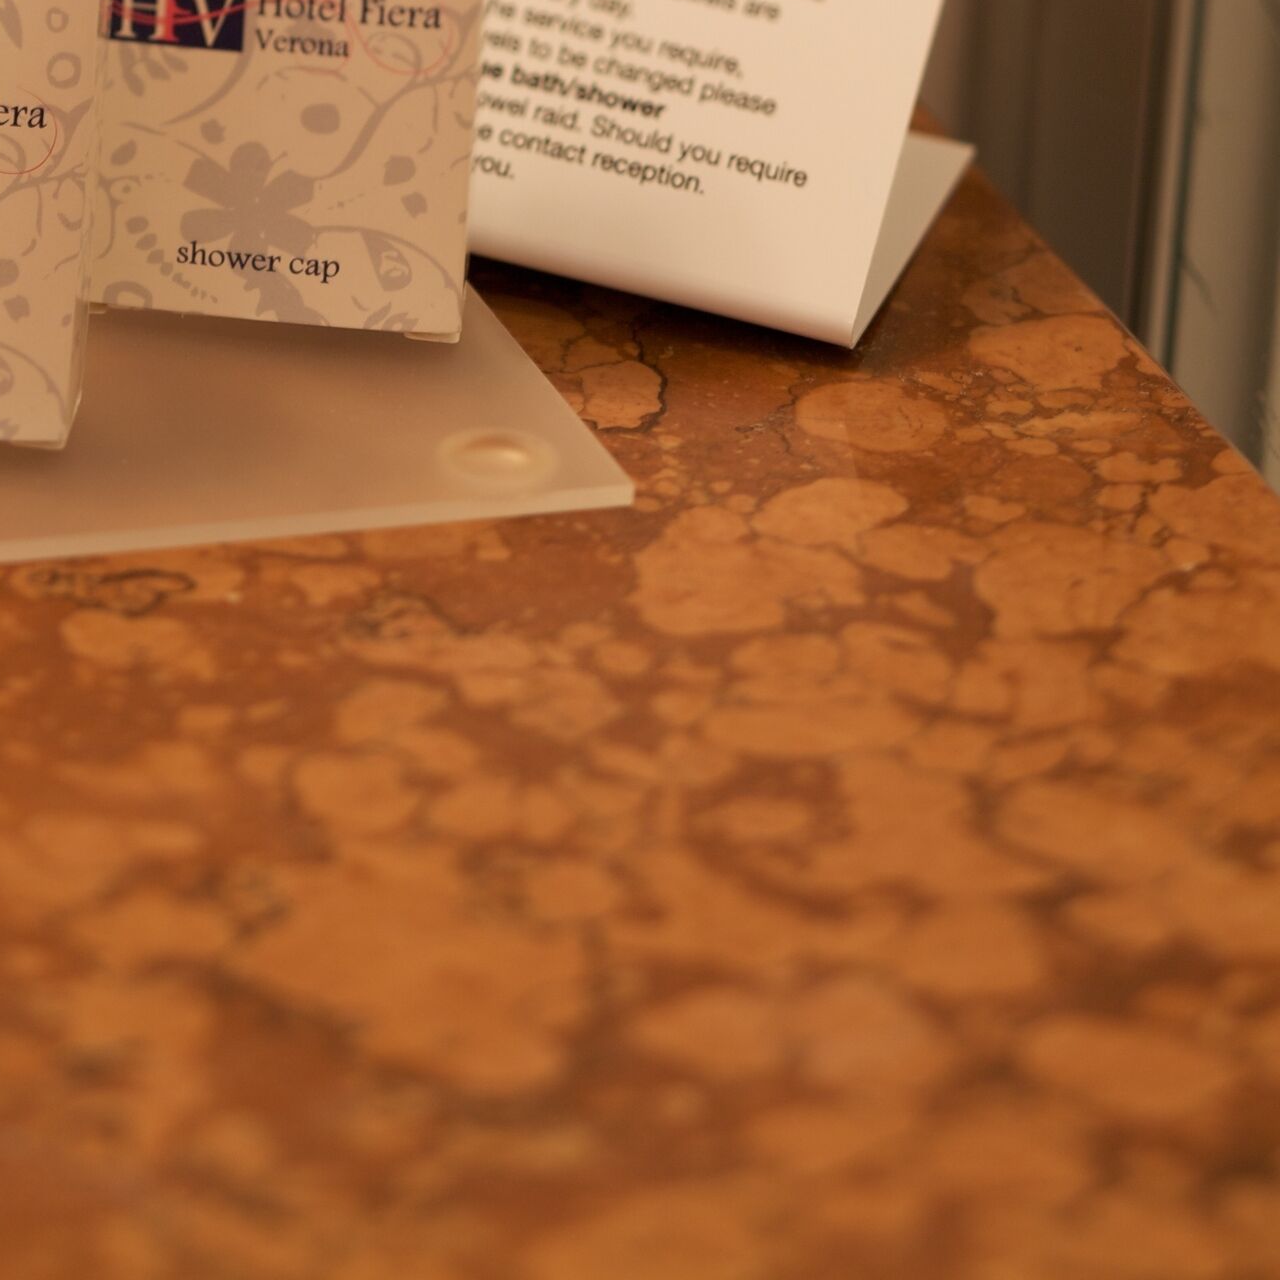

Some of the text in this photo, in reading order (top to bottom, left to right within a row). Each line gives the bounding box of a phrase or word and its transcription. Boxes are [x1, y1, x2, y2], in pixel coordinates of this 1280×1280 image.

[744, 0, 780, 20] are
[255, 28, 350, 58] Verona
[523, 7, 602, 40] service
[609, 31, 650, 55] you
[658, 40, 744, 77] require,
[510, 65, 666, 120] bath/shower
[528, 39, 551, 59] to
[557, 45, 588, 68] be
[591, 53, 695, 98] changed
[699, 80, 777, 117] please
[498, 126, 707, 196] contact reception.
[590, 114, 673, 153] Should
[677, 142, 720, 168] you
[726, 150, 809, 189] require
[176, 240, 341, 284] shower cap
